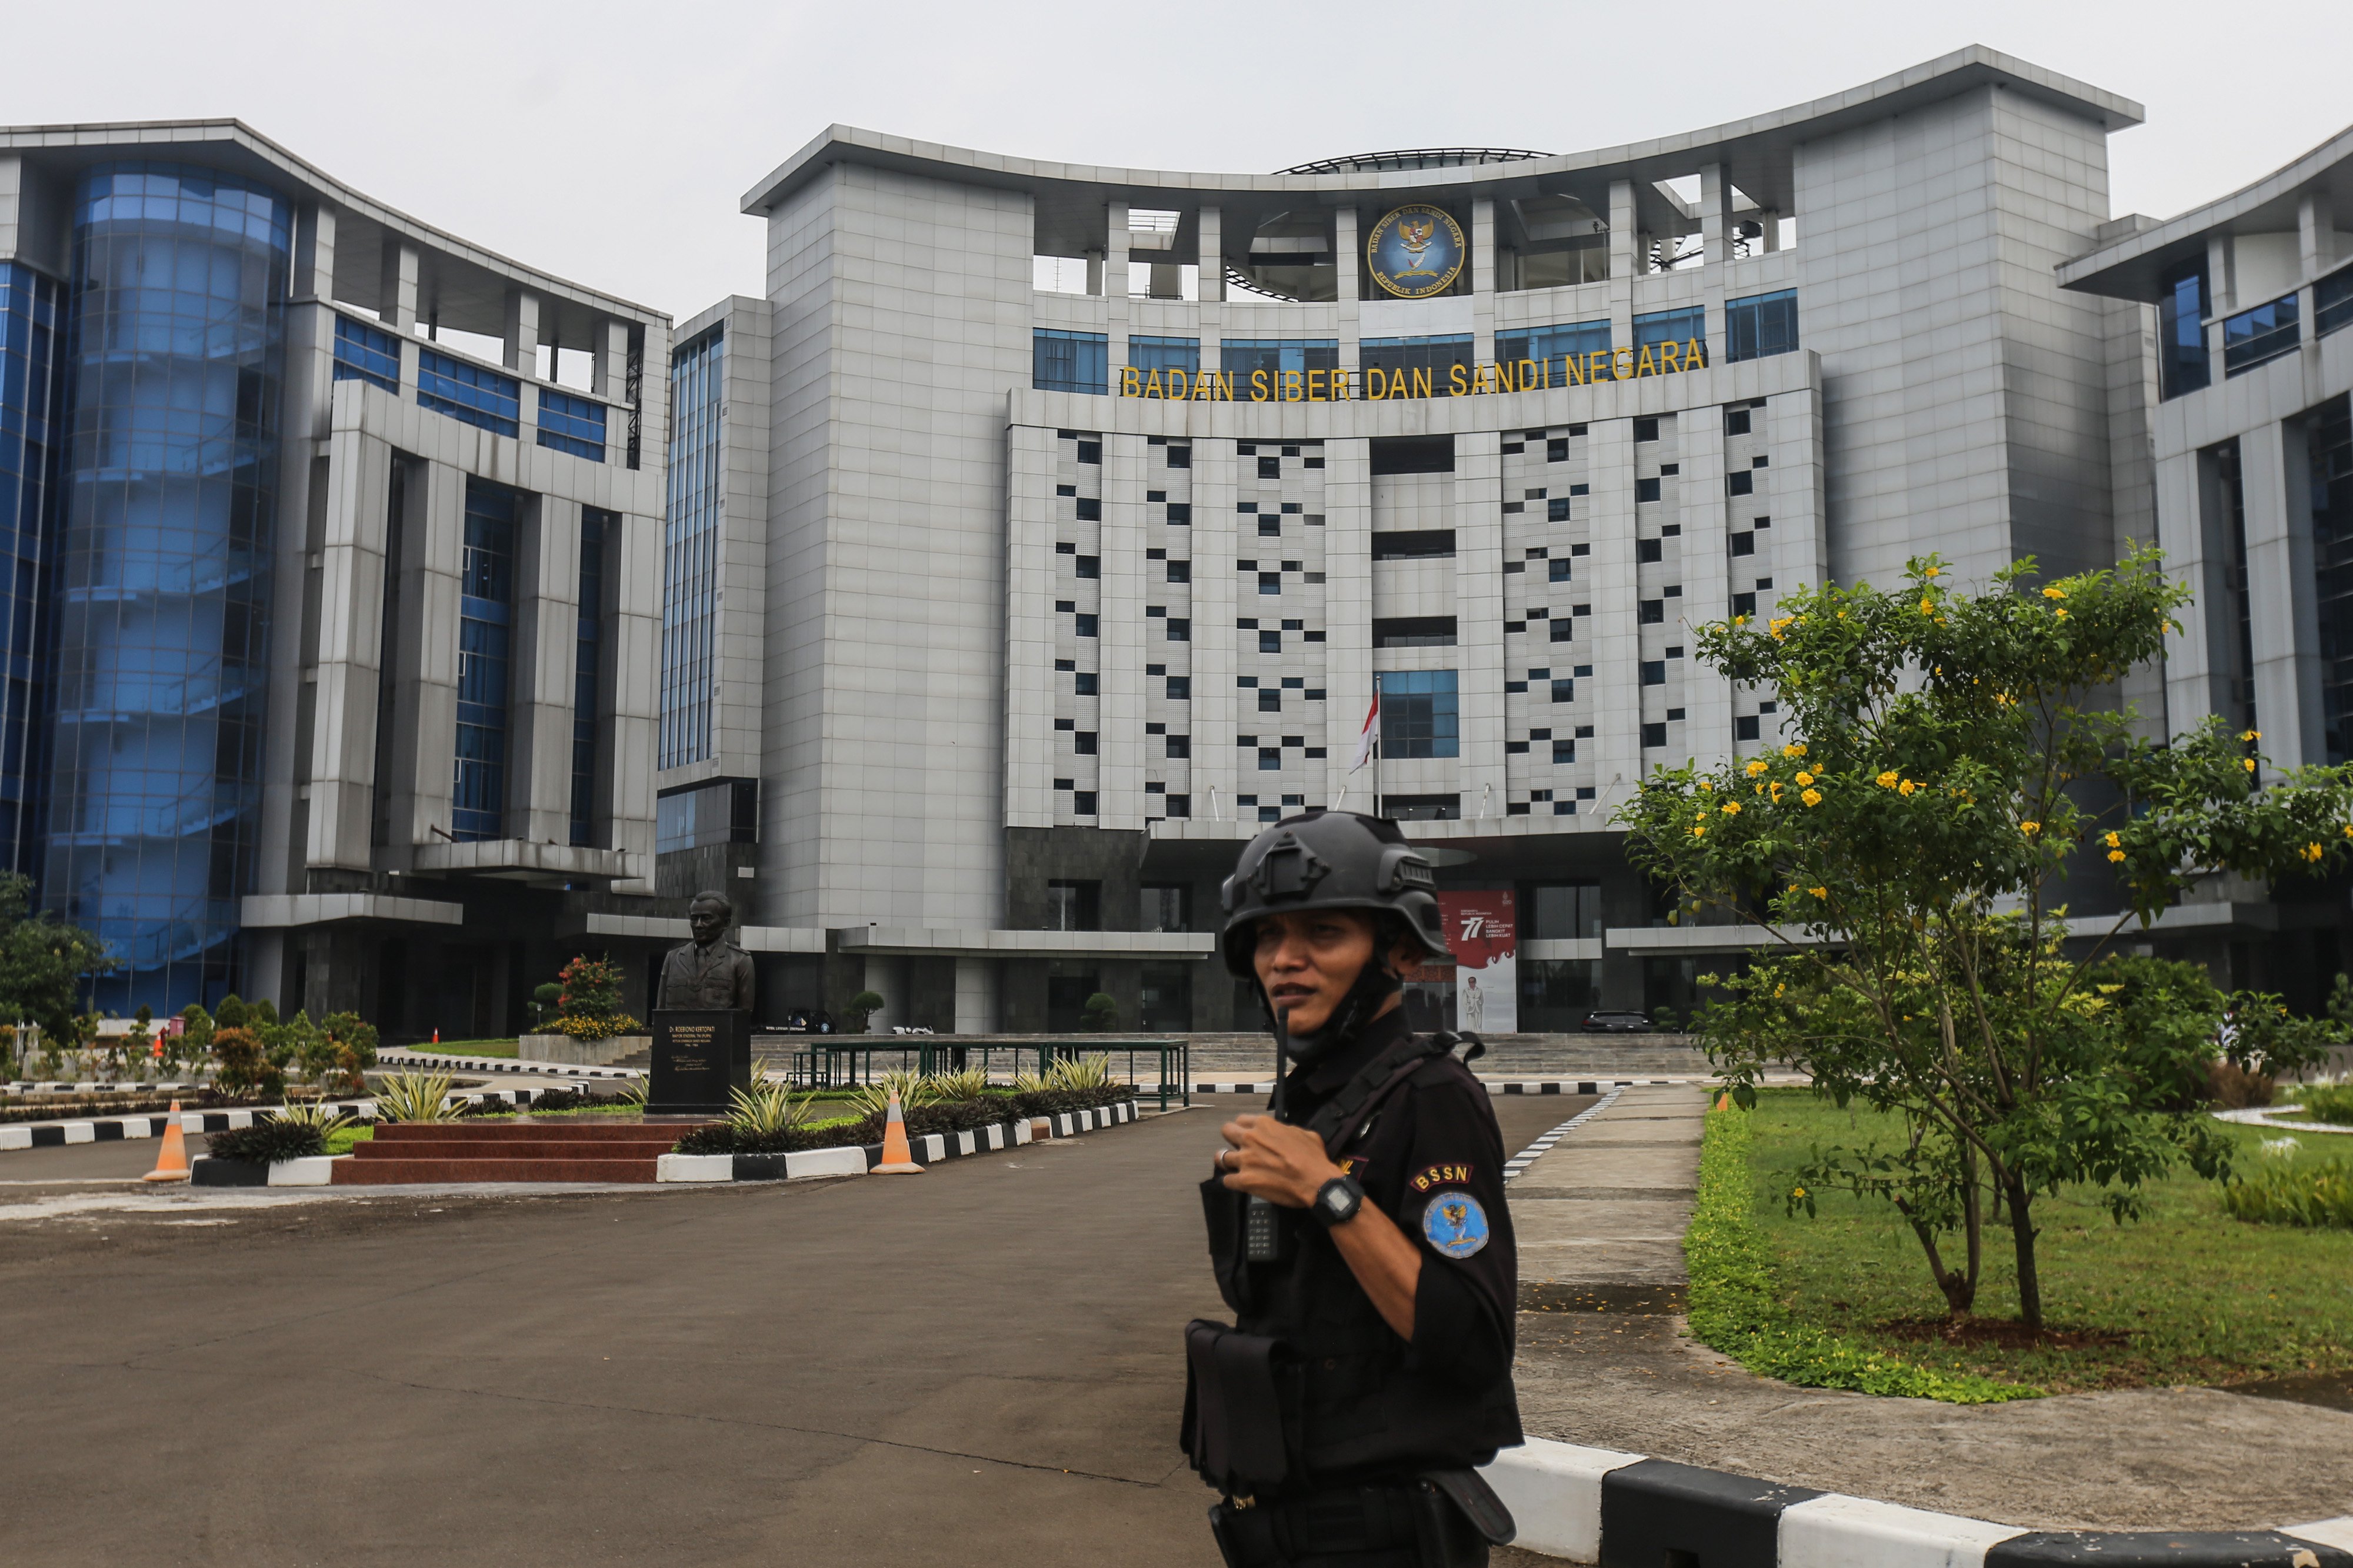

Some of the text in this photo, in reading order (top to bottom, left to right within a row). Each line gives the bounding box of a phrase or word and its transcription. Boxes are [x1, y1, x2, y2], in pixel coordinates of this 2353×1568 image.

[1371, 228, 1384, 253] BADAN
[1382, 212, 1401, 228] SIBER
[1421, 208, 1444, 220] SANDI
[1443, 218, 1462, 248] NEGARA
[1377, 266, 1457, 294] REPUBLIK INDONESIA
[1123, 338, 1705, 402] BADAN SIBER DAN SANDI NEGARA
[1461, 917, 1484, 941] 77
[1415, 1166, 1467, 1189] BSSN
